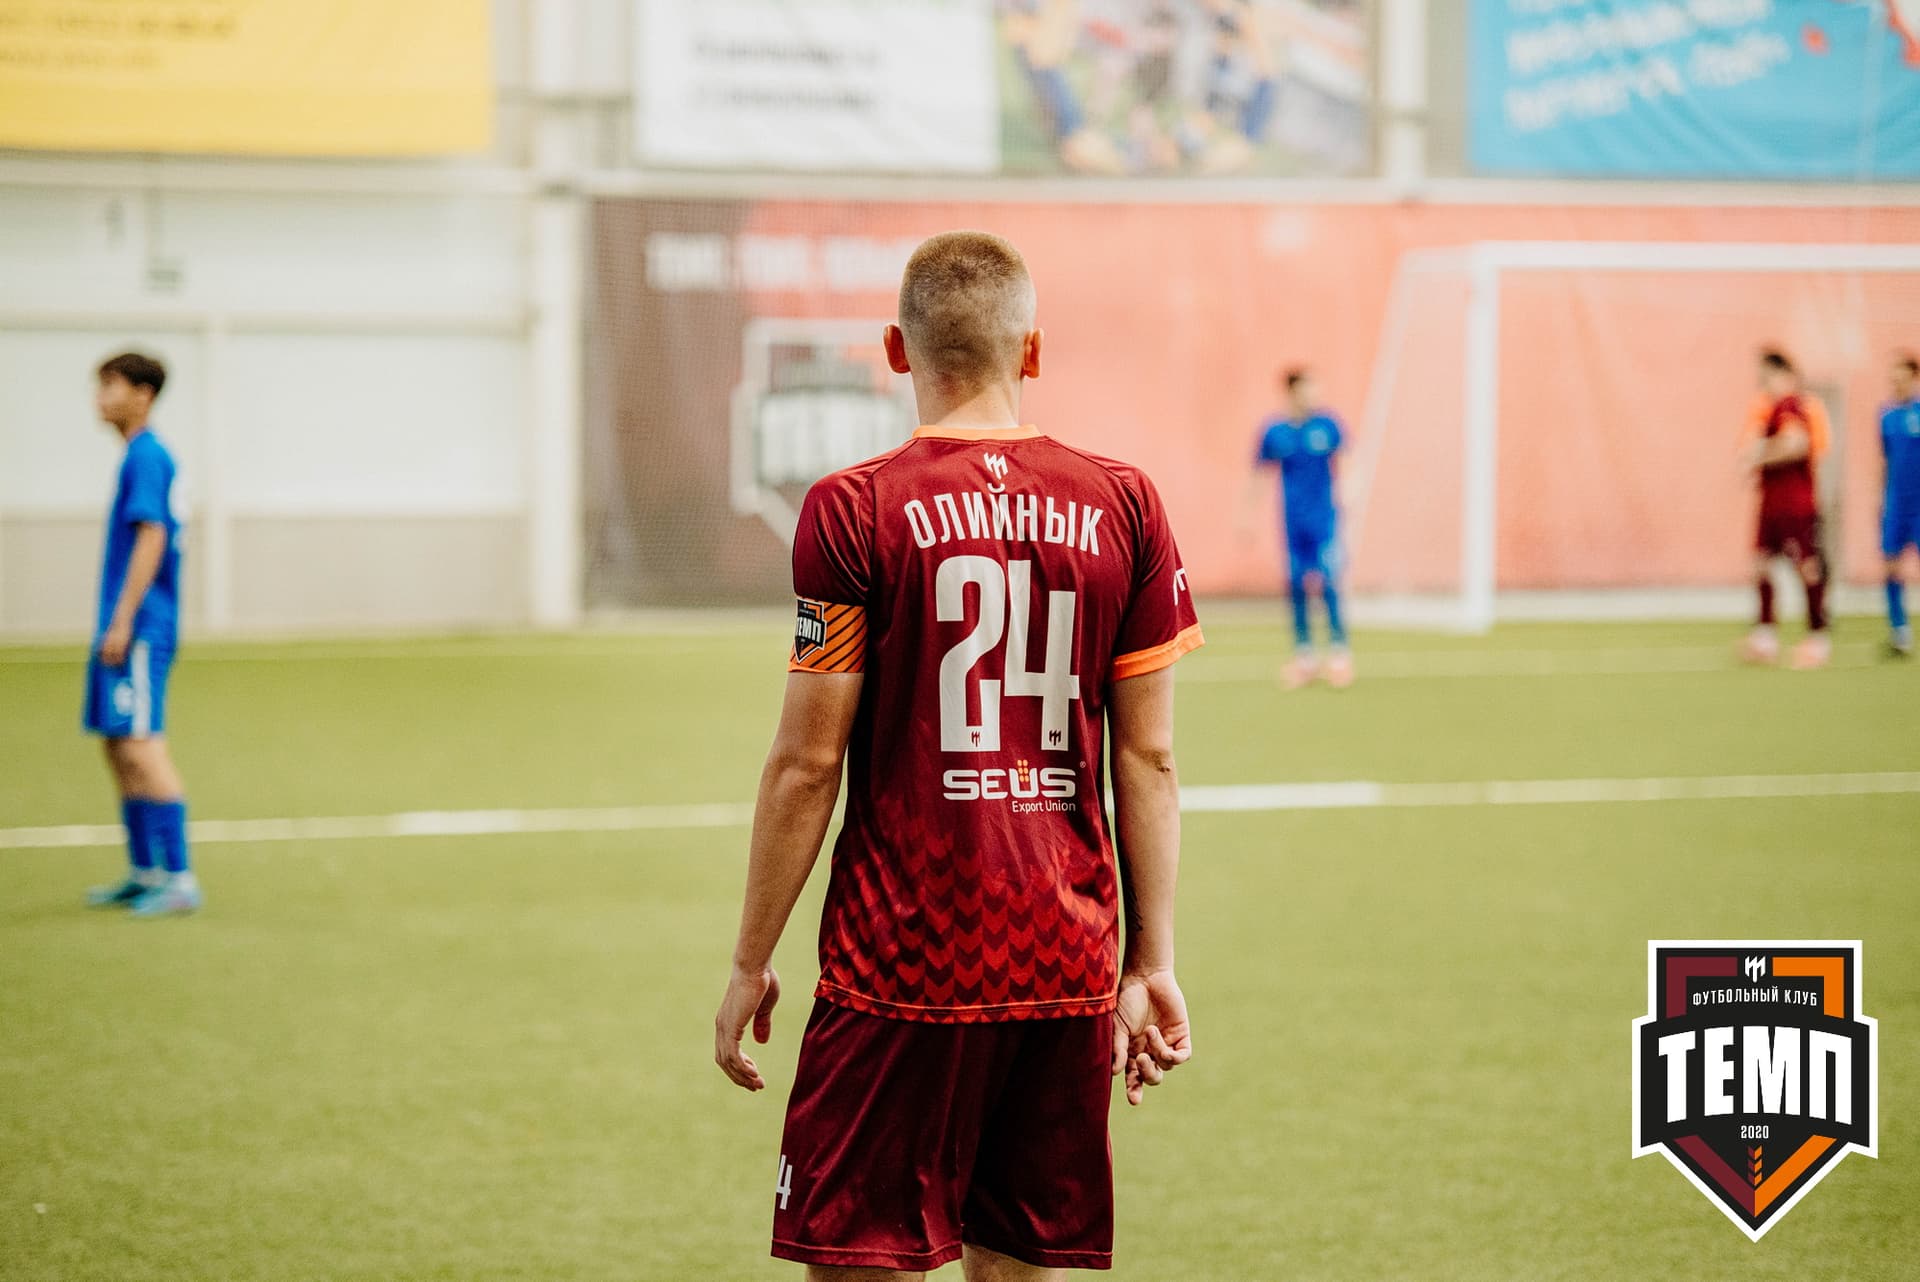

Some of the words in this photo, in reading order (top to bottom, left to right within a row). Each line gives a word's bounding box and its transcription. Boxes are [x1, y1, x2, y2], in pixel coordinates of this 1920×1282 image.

[903, 482, 1104, 556] ОЛИЙНЫК
[796, 616, 822, 643] ЕМП
[935, 555, 1080, 752] 24
[1012, 801, 1044, 814] Export
[1045, 800, 1076, 812] Union
